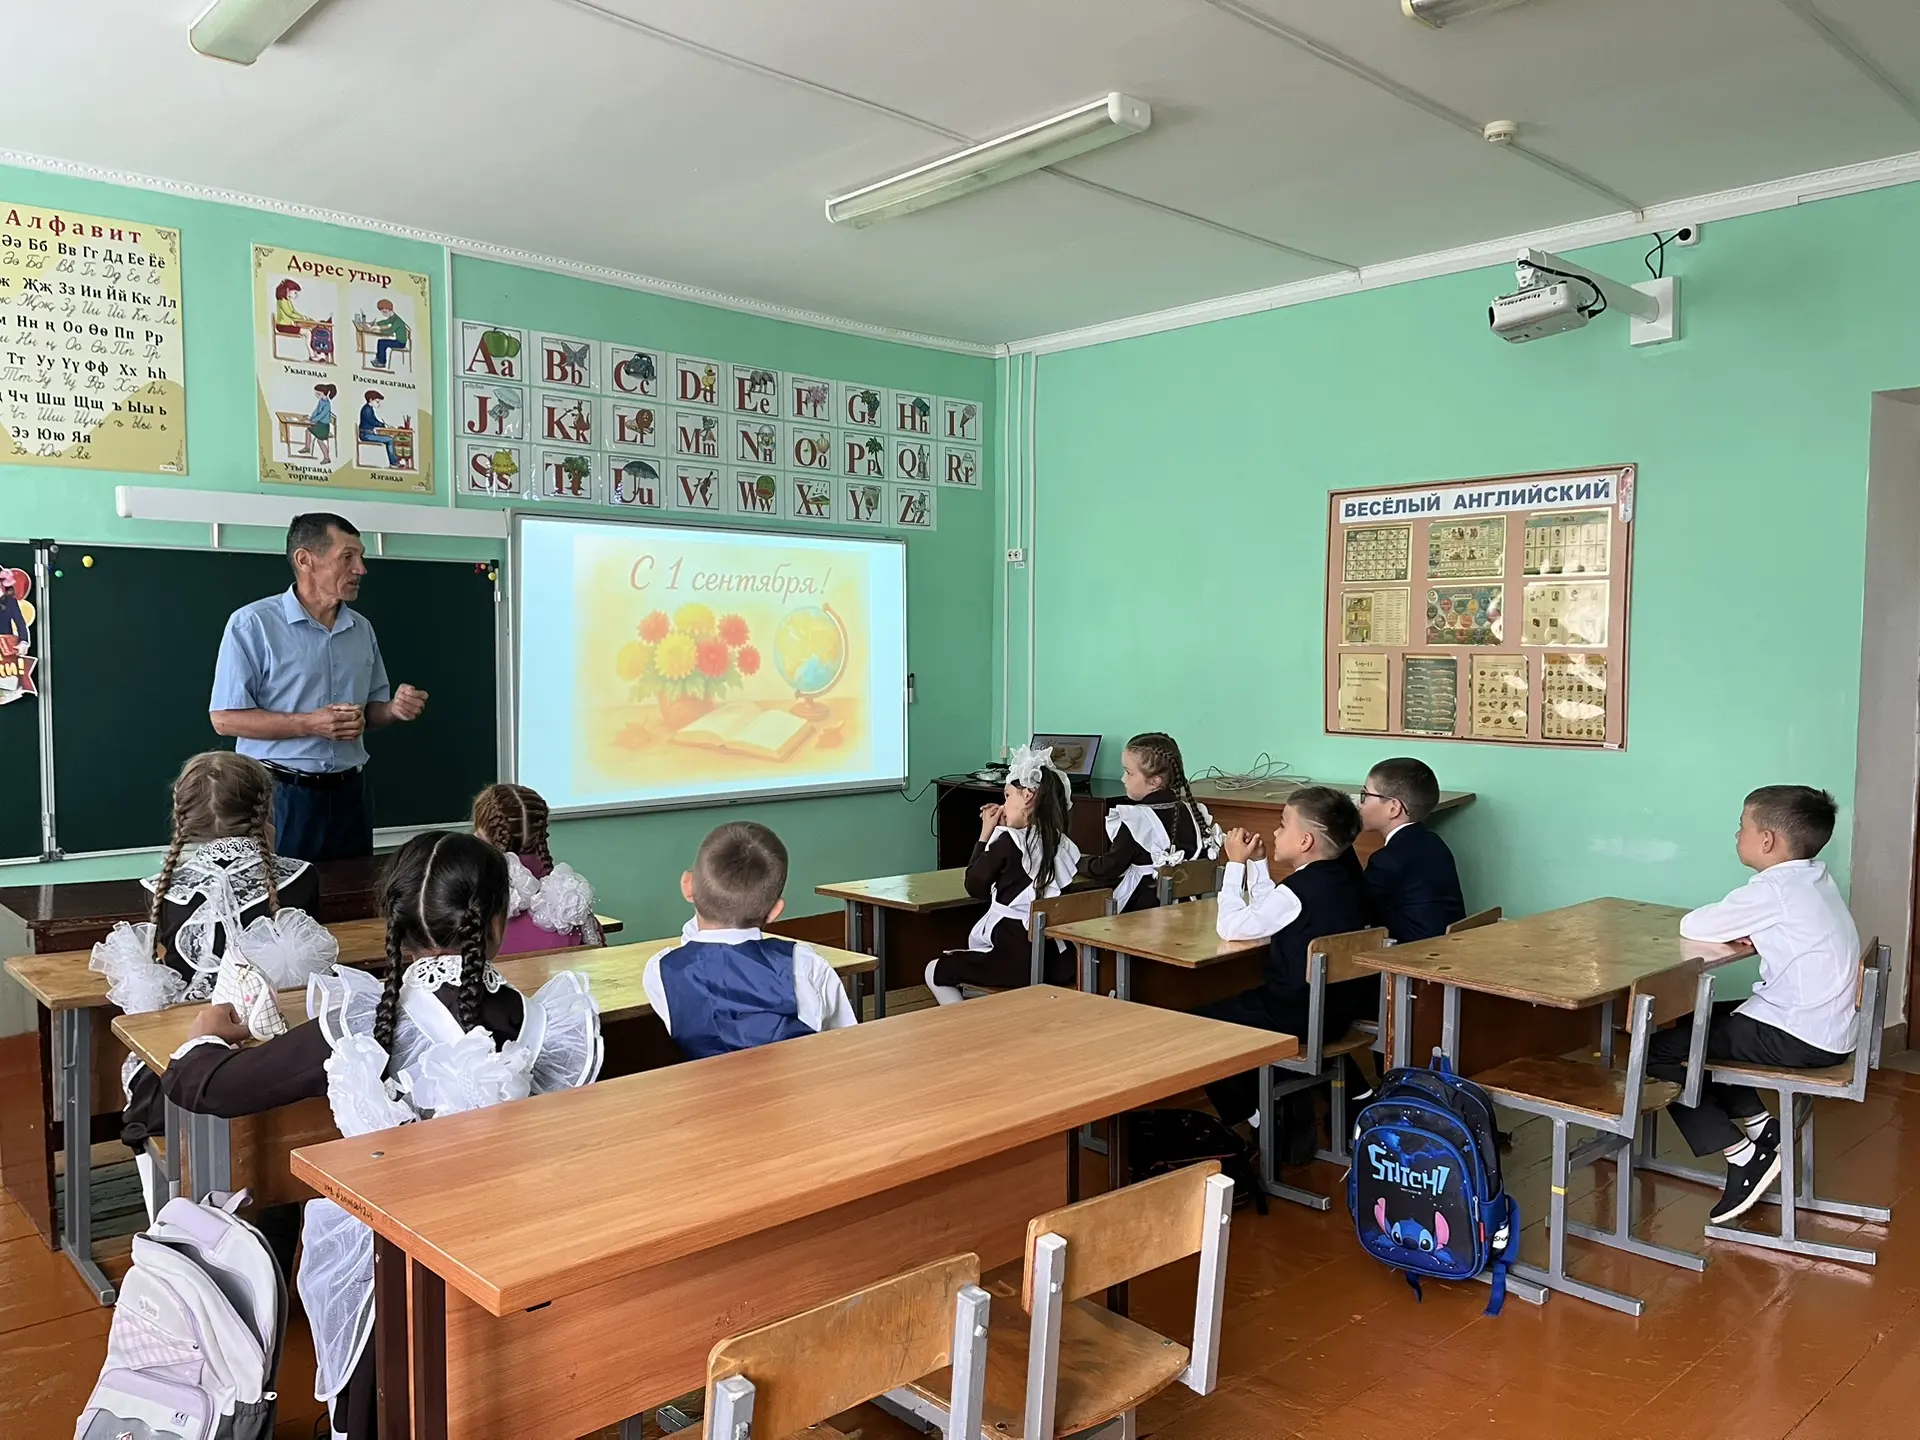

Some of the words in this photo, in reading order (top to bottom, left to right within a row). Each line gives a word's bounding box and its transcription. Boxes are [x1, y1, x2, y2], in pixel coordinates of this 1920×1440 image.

[6, 209, 141, 244] Алфавит
[2, 234, 21, 248] Әә
[28, 237, 48, 252] Бб
[58, 243, 76, 256] Вв
[83, 246, 98, 259] Гг
[103, 250, 123, 265] Дд
[128, 253, 144, 266] Ее
[149, 254, 165, 268] Ёё
[287, 255, 344, 278] Дөрес
[348, 269, 392, 288] утыр
[466, 337, 514, 378] Aa
[545, 348, 583, 385] Bb
[614, 360, 650, 394] Cc
[736, 377, 770, 414] Ee
[11, 426, 29, 438] Ээ
[37, 428, 65, 441] Юю
[72, 431, 91, 443] Яя
[679, 426, 716, 456] Mm
[284, 463, 332, 474] Утырганда
[794, 438, 827, 468] Oo
[846, 442, 876, 475] Pp
[948, 454, 972, 482] Rr
[288, 472, 328, 482] торганда
[1344, 492, 1440, 518] ВЕСЁЛЫЙ
[1453, 479, 1610, 510] АНГЛИЙСКИЙ
[630, 555, 654, 590] С
[666, 556, 684, 590] 1
[692, 563, 832, 604] сентября!
[1368, 1144, 1450, 1196] STITCH!
